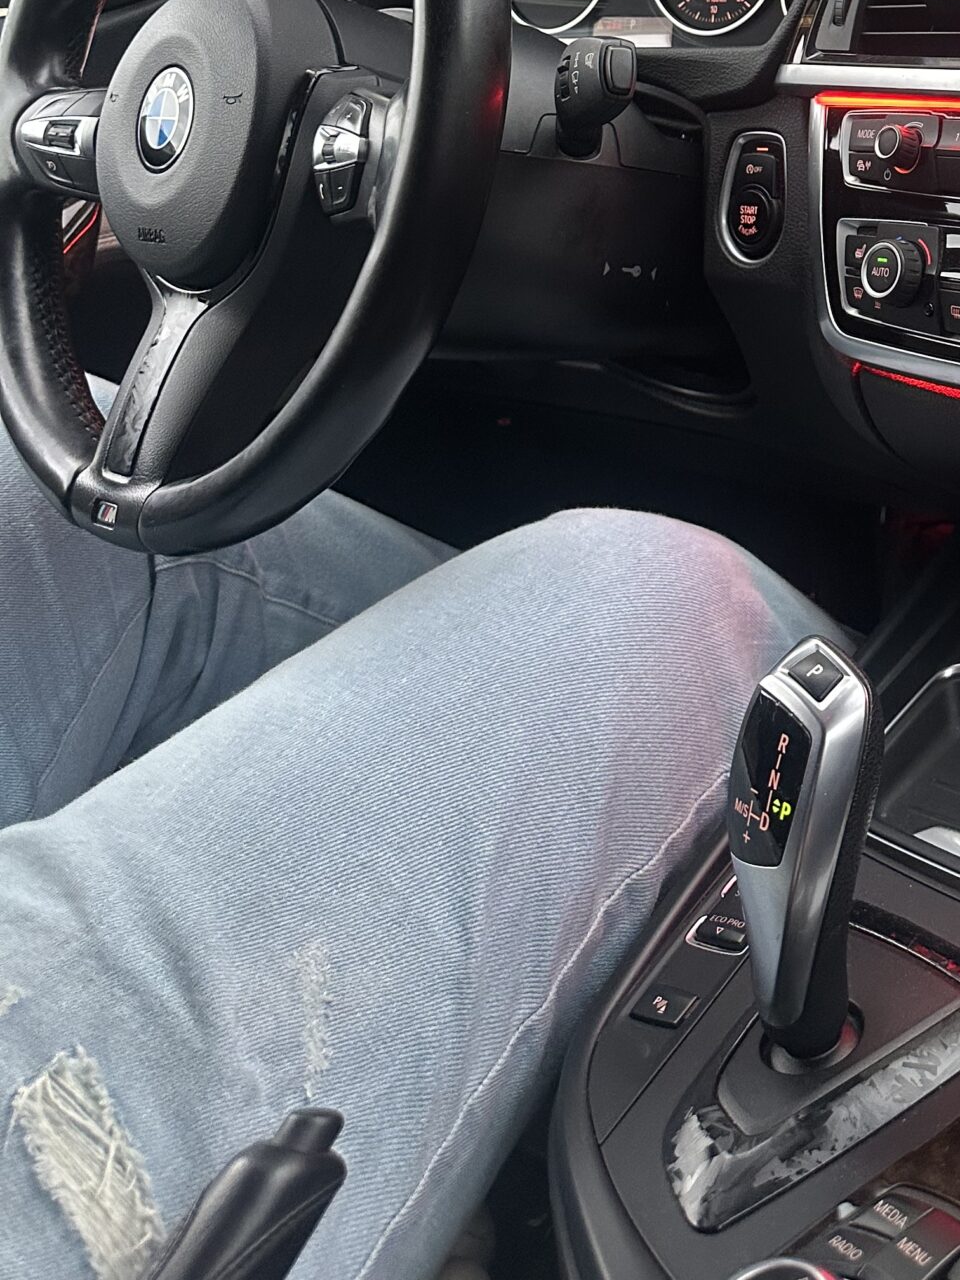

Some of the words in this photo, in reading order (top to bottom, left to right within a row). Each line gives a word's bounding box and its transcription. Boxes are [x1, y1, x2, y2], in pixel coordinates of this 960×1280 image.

[856, 129, 876, 140] MODE
[954, 132, 960, 142] 1
[740, 205, 758, 215] START
[740, 215, 756, 225] STOP
[871, 267, 890, 278] AUTO
[806, 663, 824, 677] P
[777, 733, 790, 755] R
[768, 769, 781, 790] N
[734, 797, 750, 818] M/S
[779, 801, 792, 820] P
[759, 812, 770, 832] D
[709, 914, 728, 924] ECO
[727, 917, 746, 929] PRO
[873, 1199, 909, 1230] MEDIA
[827, 1234, 864, 1261] RADIO
[896, 1236, 933, 1267] MENU
